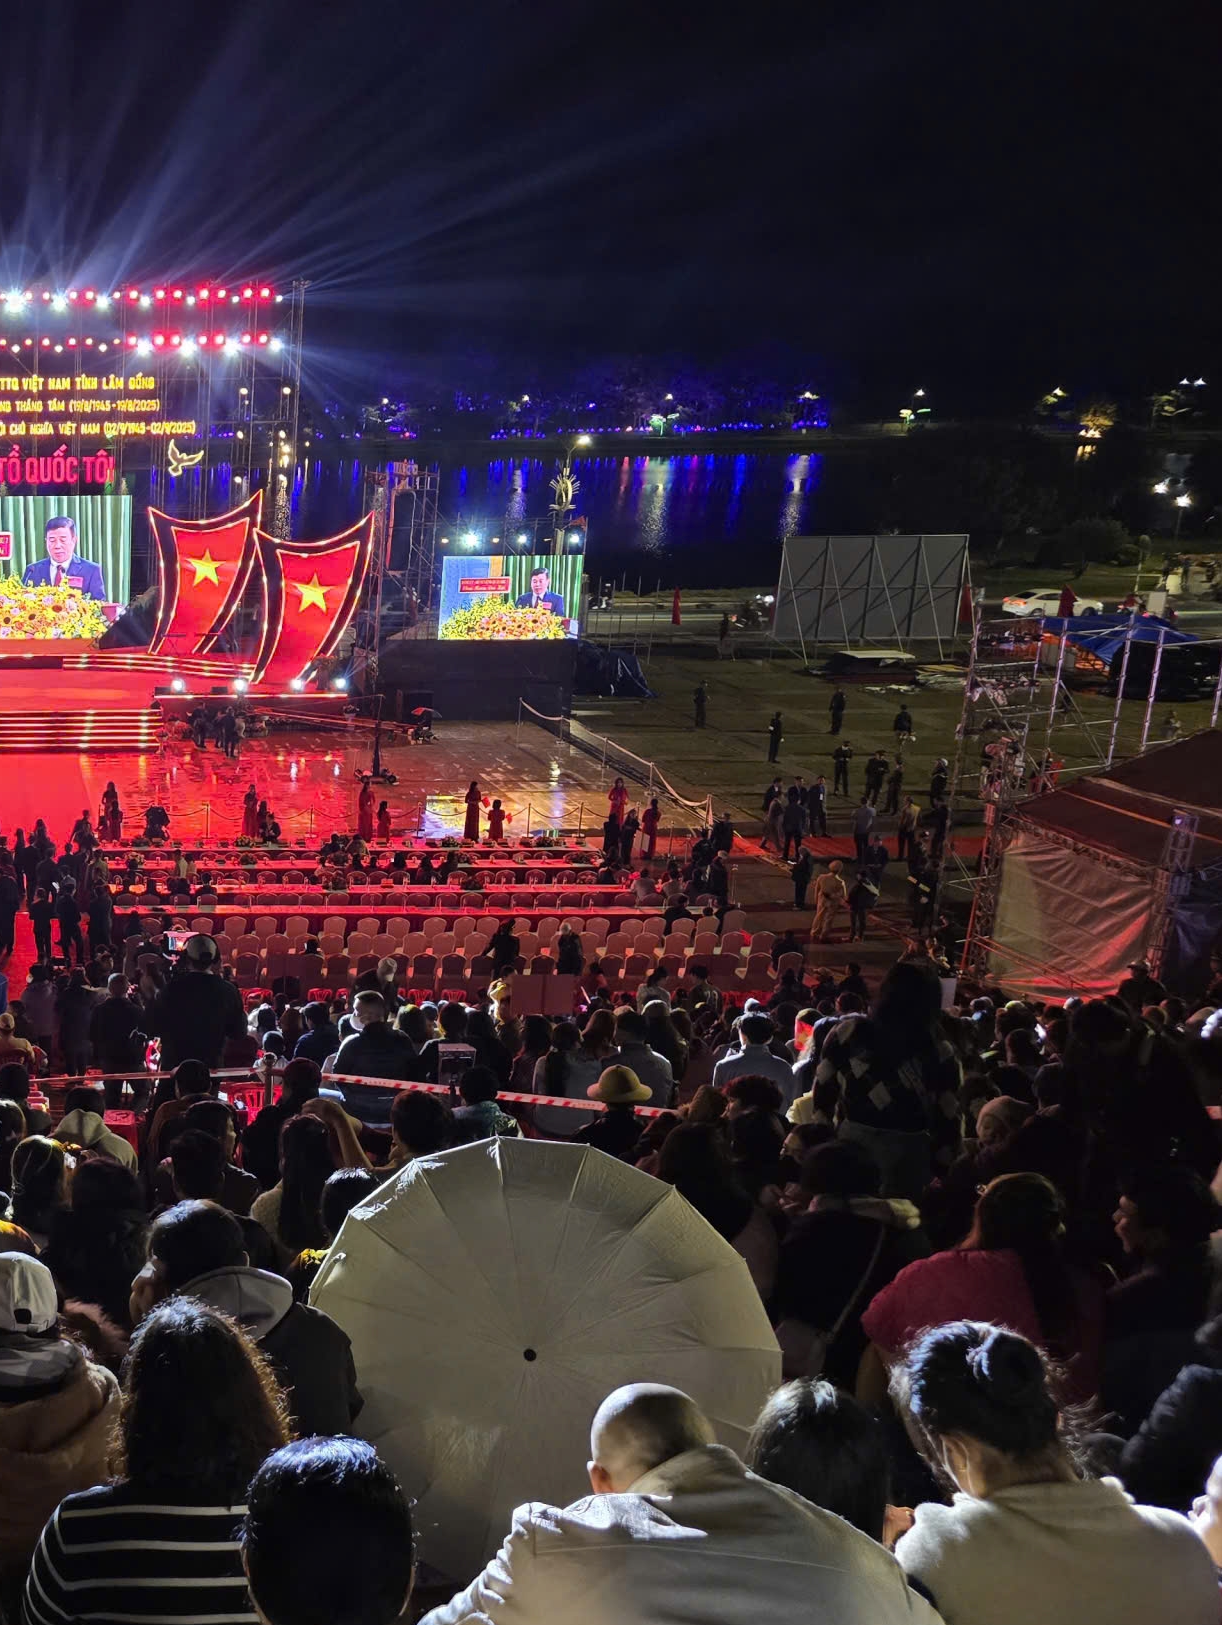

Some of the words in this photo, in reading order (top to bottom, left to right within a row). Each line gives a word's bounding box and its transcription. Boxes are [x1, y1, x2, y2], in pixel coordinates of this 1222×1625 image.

[22, 374, 44, 393] VIỆT
[48, 377, 71, 390] NAM
[102, 374, 124, 390] LÂM
[15, 398, 43, 412] THÁNG
[48, 397, 65, 412] TÁM
[9, 420, 26, 435] CHỦ
[30, 420, 54, 435] NGHĨA
[59, 420, 77, 436] VIỆT
[81, 422, 100, 435] NAM
[25, 443, 78, 484] QUỐC
